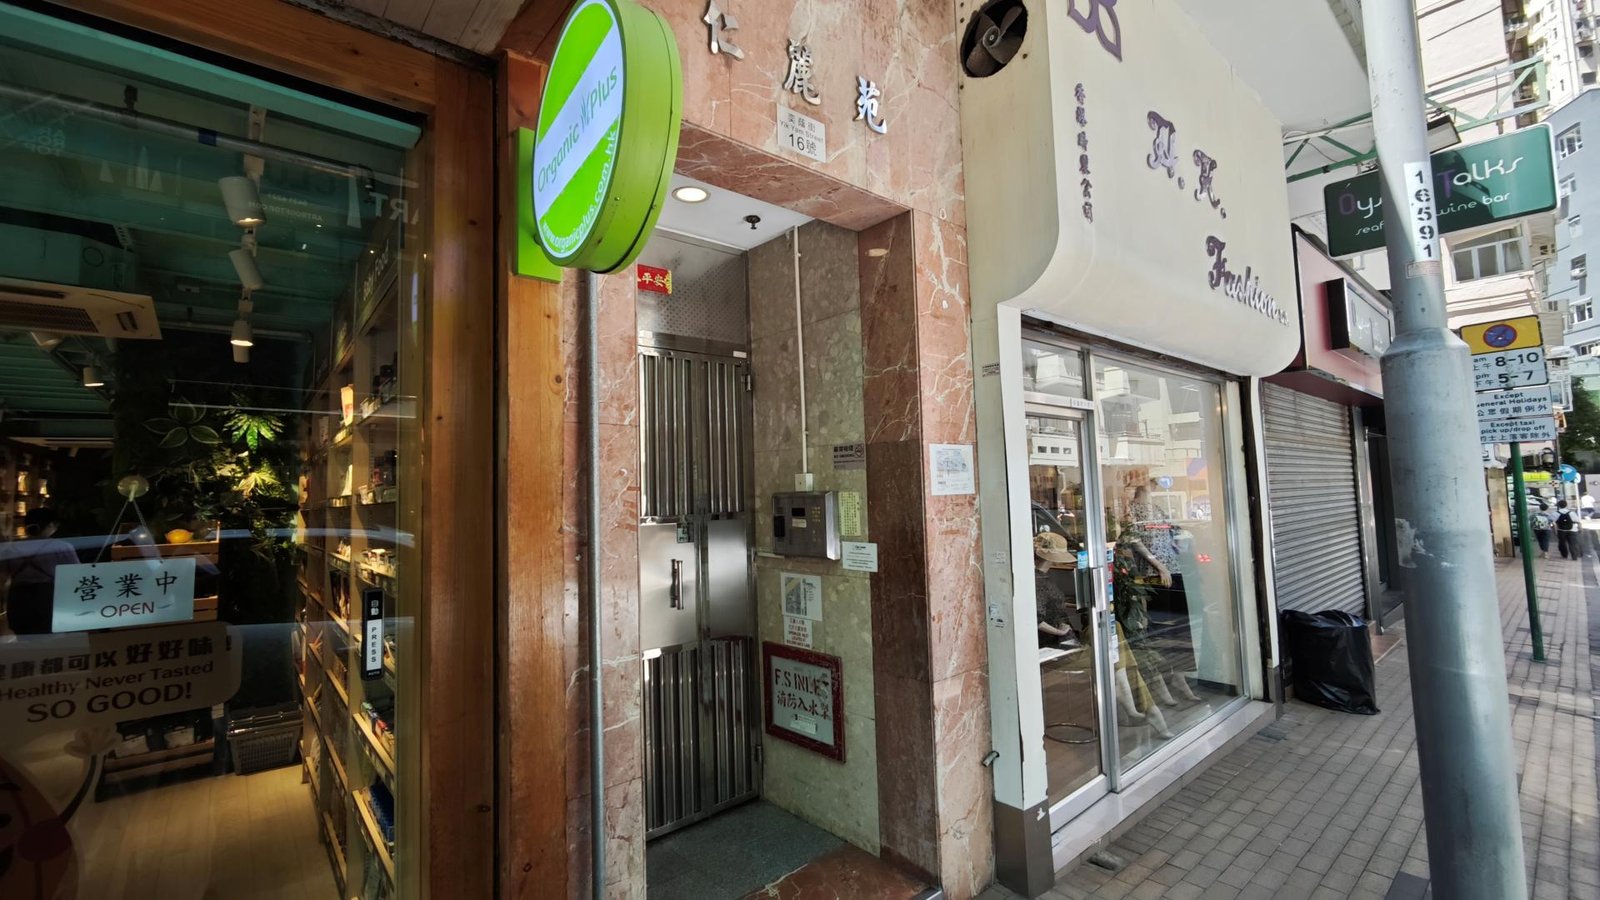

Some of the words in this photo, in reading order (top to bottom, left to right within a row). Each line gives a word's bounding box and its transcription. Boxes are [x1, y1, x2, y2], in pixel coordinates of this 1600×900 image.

[537, 124, 581, 194] Organic
[589, 65, 618, 122] Plus
[541, 129, 617, 253] www.organicplus.com.hk
[1436, 155, 1524, 199] Talks
[1414, 169, 1435, 258] 16591
[1435, 200, 1478, 217] wine
[1481, 191, 1512, 206] bar
[1205, 234, 1277, 319] Fashion
[1495, 352, 1540, 367] 8-10
[1498, 370, 1534, 384] 5-7
[1494, 392, 1524, 400] Except
[1509, 396, 1548, 405] Holidays
[1481, 427, 1498, 435] pick
[1490, 420, 1518, 428] Except
[73, 570, 178, 602] 營業中
[100, 601, 155, 618] OPEN
[0, 680, 81, 702] Healthy
[85, 669, 145, 690] Never
[150, 660, 214, 681] Tasted
[27, 699, 76, 724] SO
[86, 681, 192, 715] GOOD!
